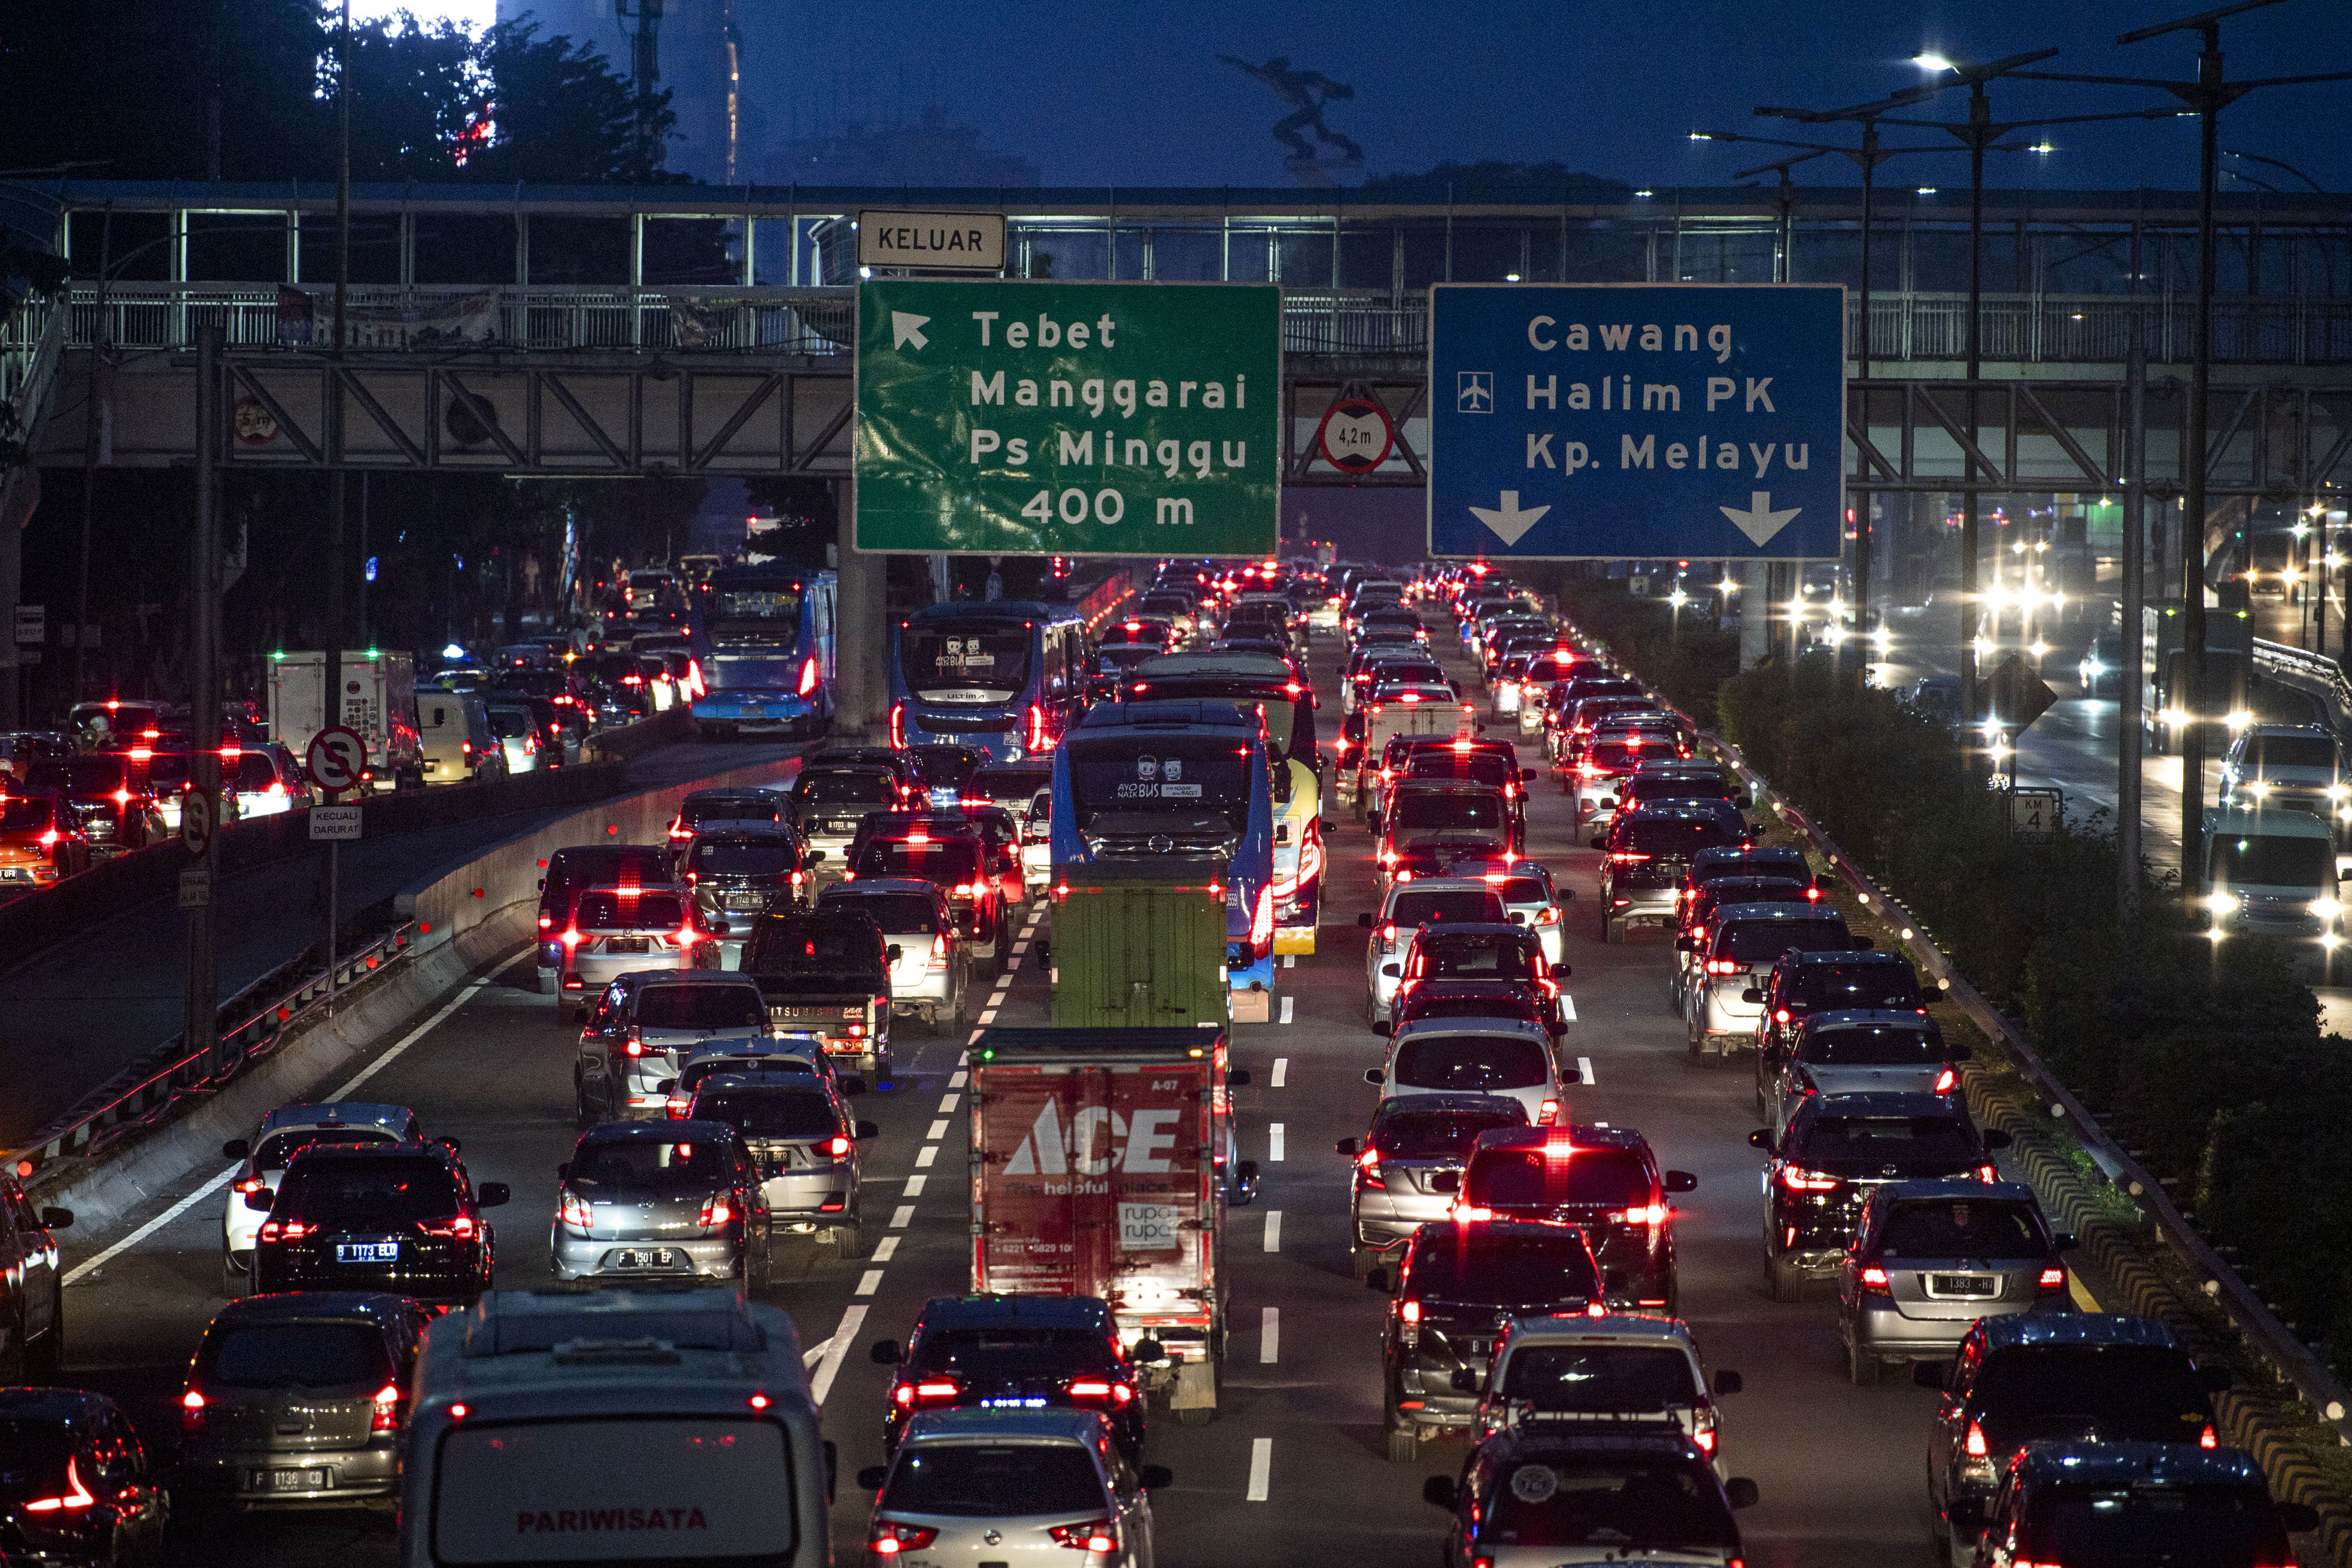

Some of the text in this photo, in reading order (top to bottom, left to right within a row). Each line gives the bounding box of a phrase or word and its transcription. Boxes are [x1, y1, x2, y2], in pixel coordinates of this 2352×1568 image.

[878, 228, 983, 252] KELUAR
[973, 312, 1116, 349] Tebet
[1528, 315, 1732, 363] Cawang
[971, 371, 1245, 419] Manggarai
[1526, 374, 1776, 413] Halim PK
[1338, 427, 1371, 446] 4,2 m
[971, 429, 1246, 479] Ps Minggu
[1526, 433, 1809, 479] Kp. Melayu
[1021, 488, 1194, 525] 400 m
[951, 656, 965, 667] BUS
[1117, 783, 1138, 791] AYO
[1138, 783, 1160, 798] BUS
[2024, 799, 2042, 809] KM
[315, 811, 358, 821] KECUALI
[2027, 810, 2042, 830] 4
[313, 825, 359, 834] DARURAT
[4, 870, 16, 878] UFR
[1151, 1079, 1178, 1091] A-07
[1002, 1096, 1181, 1175] ACE
[1044, 1180, 1108, 1195] helpful
[338, 1244, 344, 1256] B
[352, 1244, 375, 1256] 1173
[619, 1252, 672, 1263] F 1501 EP
[1950, 1277, 1971, 1289] 1383
[256, 1472, 262, 1485] F
[517, 1507, 708, 1534] PARIWISATA
